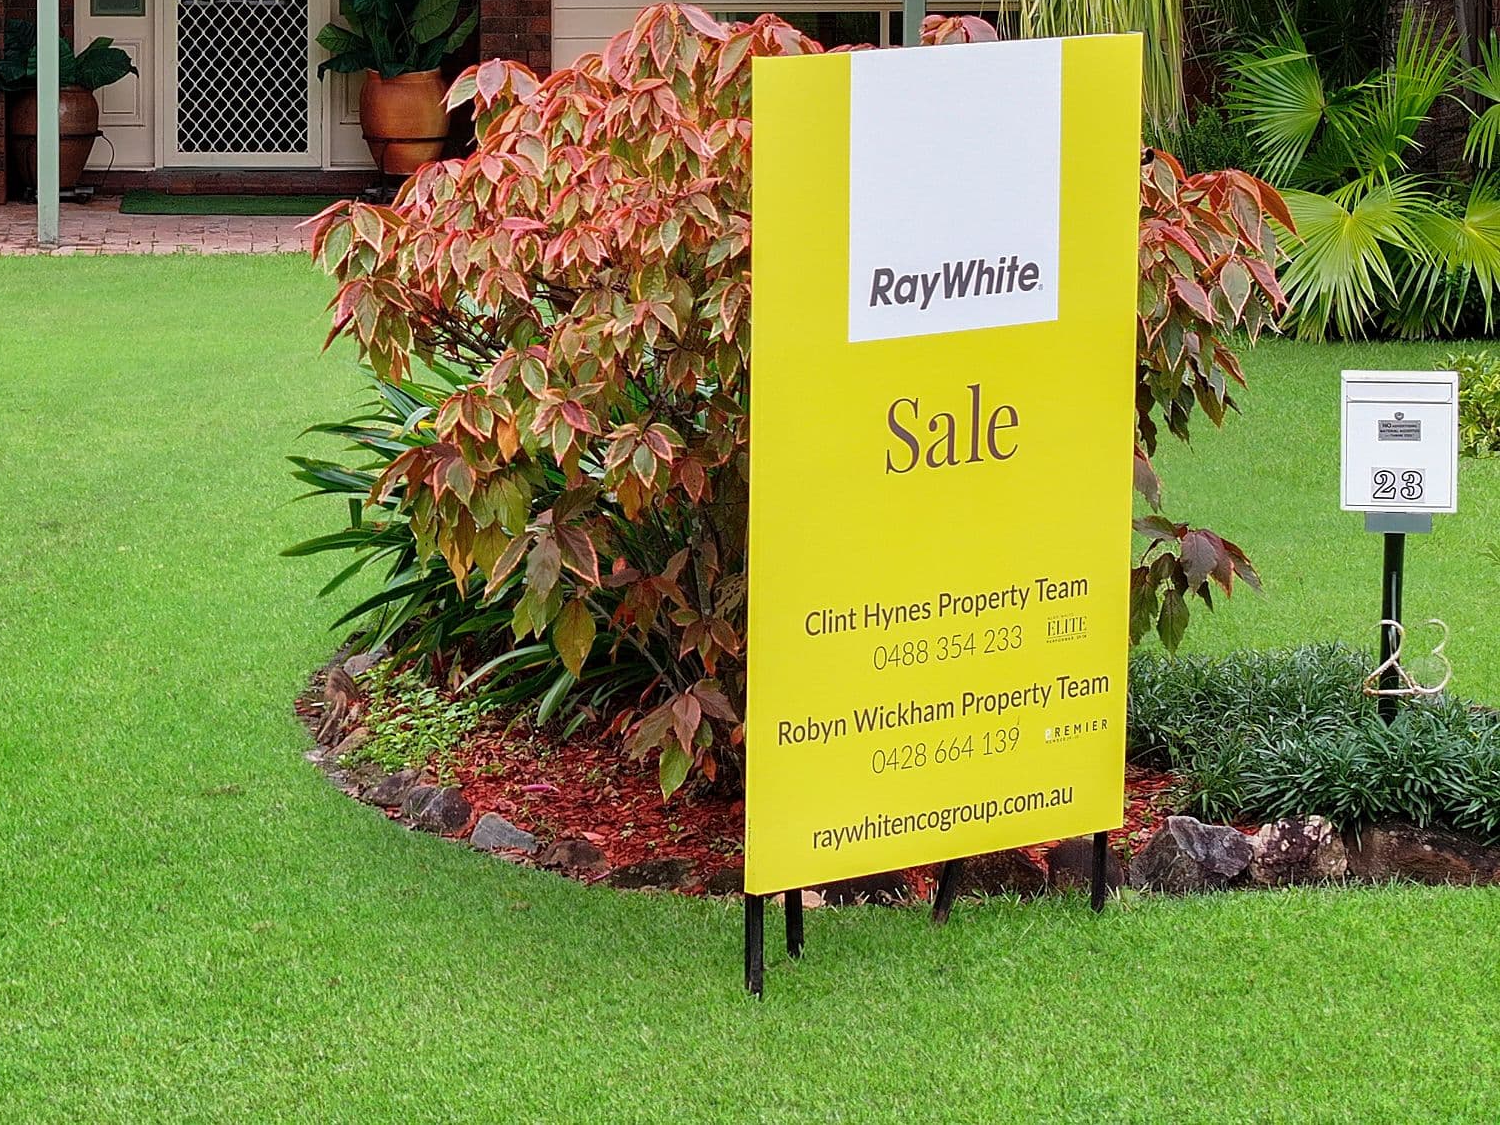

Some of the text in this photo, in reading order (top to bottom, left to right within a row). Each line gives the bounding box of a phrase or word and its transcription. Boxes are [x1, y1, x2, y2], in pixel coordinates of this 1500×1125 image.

[869, 256, 1040, 310] RayWhite
[885, 383, 1019, 475] Sale
[1373, 470, 1423, 499] 23
[805, 578, 1088, 636] Clint Hynes Property Team
[1047, 616, 1087, 636] ELITE
[873, 625, 1023, 670] 0488 354 233
[778, 675, 1109, 746] Robyn Wickham Property Team
[872, 726, 1020, 774] 0428 664 139
[812, 786, 1073, 851] raywhitencogroup.com.au
